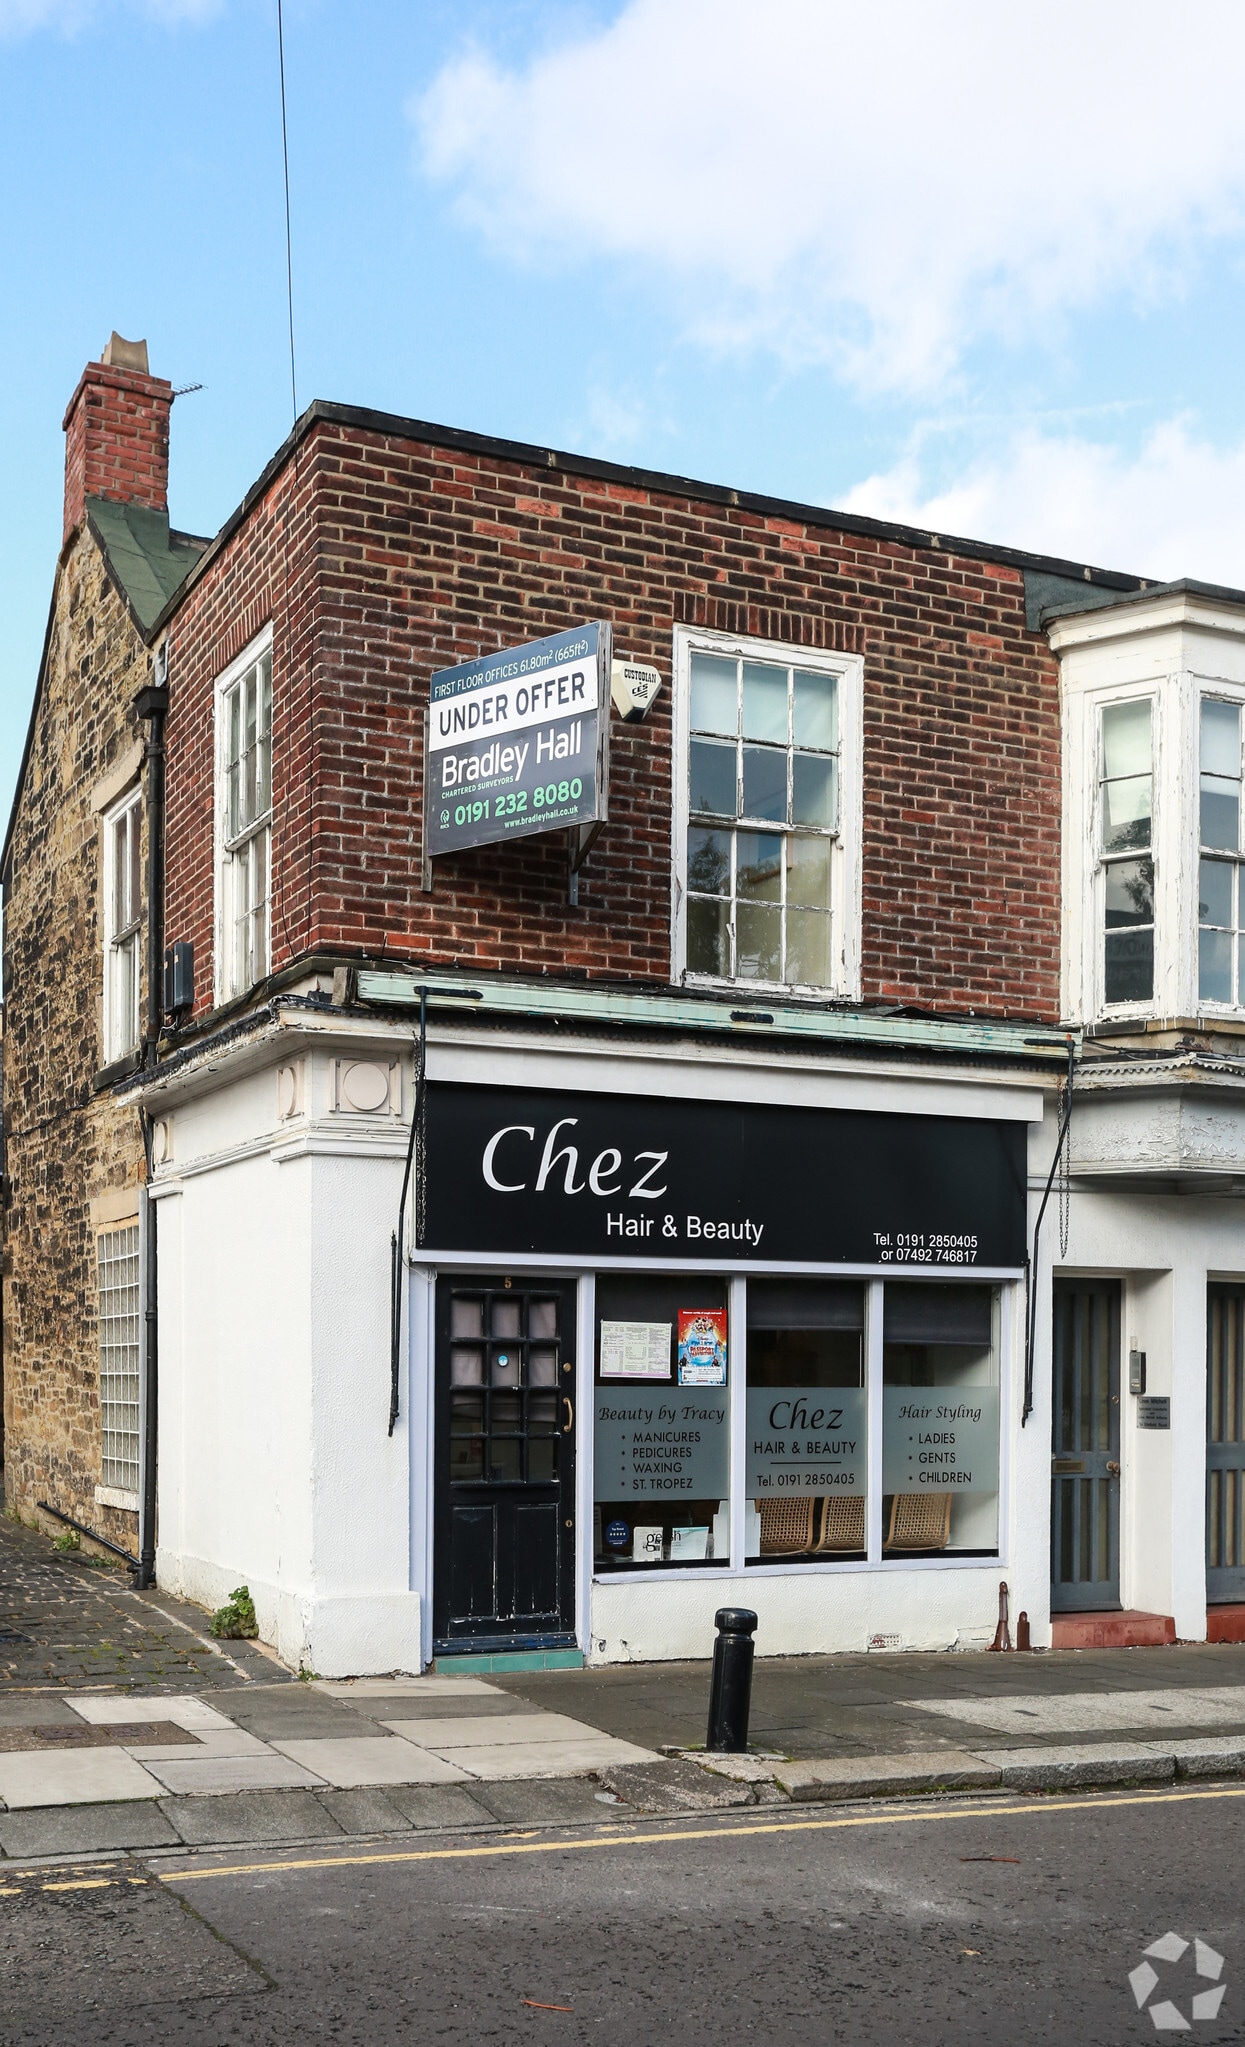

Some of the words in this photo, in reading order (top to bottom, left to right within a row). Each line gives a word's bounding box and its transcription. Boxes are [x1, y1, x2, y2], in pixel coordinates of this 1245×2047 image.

[434, 682, 456, 699] FIRST
[457, 674, 484, 691] FLOOR
[485, 663, 518, 683] OFFICES
[624, 668, 657, 684] CUSTODIAN
[439, 693, 508, 737] UNDER
[515, 671, 585, 716] OFFER
[441, 741, 530, 788] Bradley
[536, 720, 583, 764] Hall
[441, 784, 477, 800] CHARTERED
[477, 775, 514, 791] SURVEYORS
[454, 799, 490, 826] 0191
[494, 790, 528, 817] 232
[533, 777, 583, 808] 8080
[504, 804, 579, 829] www.bradleyhall.co.uk
[481, 1117, 669, 1199] Chez
[606, 1212, 655, 1237] Hair
[661, 1214, 679, 1238] &
[686, 1215, 764, 1246] Beauty
[872, 1232, 894, 1246] Tel.
[896, 1233, 925, 1247] 0191
[928, 1234, 978, 1248] 2850405
[881, 1249, 894, 1261] or
[896, 1247, 933, 1262] 07492
[935, 1249, 978, 1263] 746817
[504, 1276, 512, 1289] 5
[598, 1406, 654, 1425] Beauty
[658, 1404, 677, 1425] by
[680, 1404, 726, 1425] Tracy
[769, 1397, 844, 1430] Chez
[898, 1404, 933, 1419] Hair
[935, 1404, 982, 1423] Styling
[633, 1431, 701, 1443] MANICURES
[918, 1433, 956, 1444] LADIES
[632, 1446, 692, 1458] PEDICURES
[754, 1441, 785, 1454] HAIR
[791, 1441, 801, 1454] &
[807, 1441, 857, 1454] BEAUTY
[918, 1452, 956, 1464] GENTS
[632, 1461, 683, 1473] WAXING
[632, 1479, 647, 1490] ST.
[650, 1478, 693, 1490] TROPEZ
[757, 1475, 775, 1487] Tel.
[777, 1474, 801, 1486] 0191
[804, 1473, 855, 1486] 2850405
[918, 1471, 972, 1483] CHILDREN
